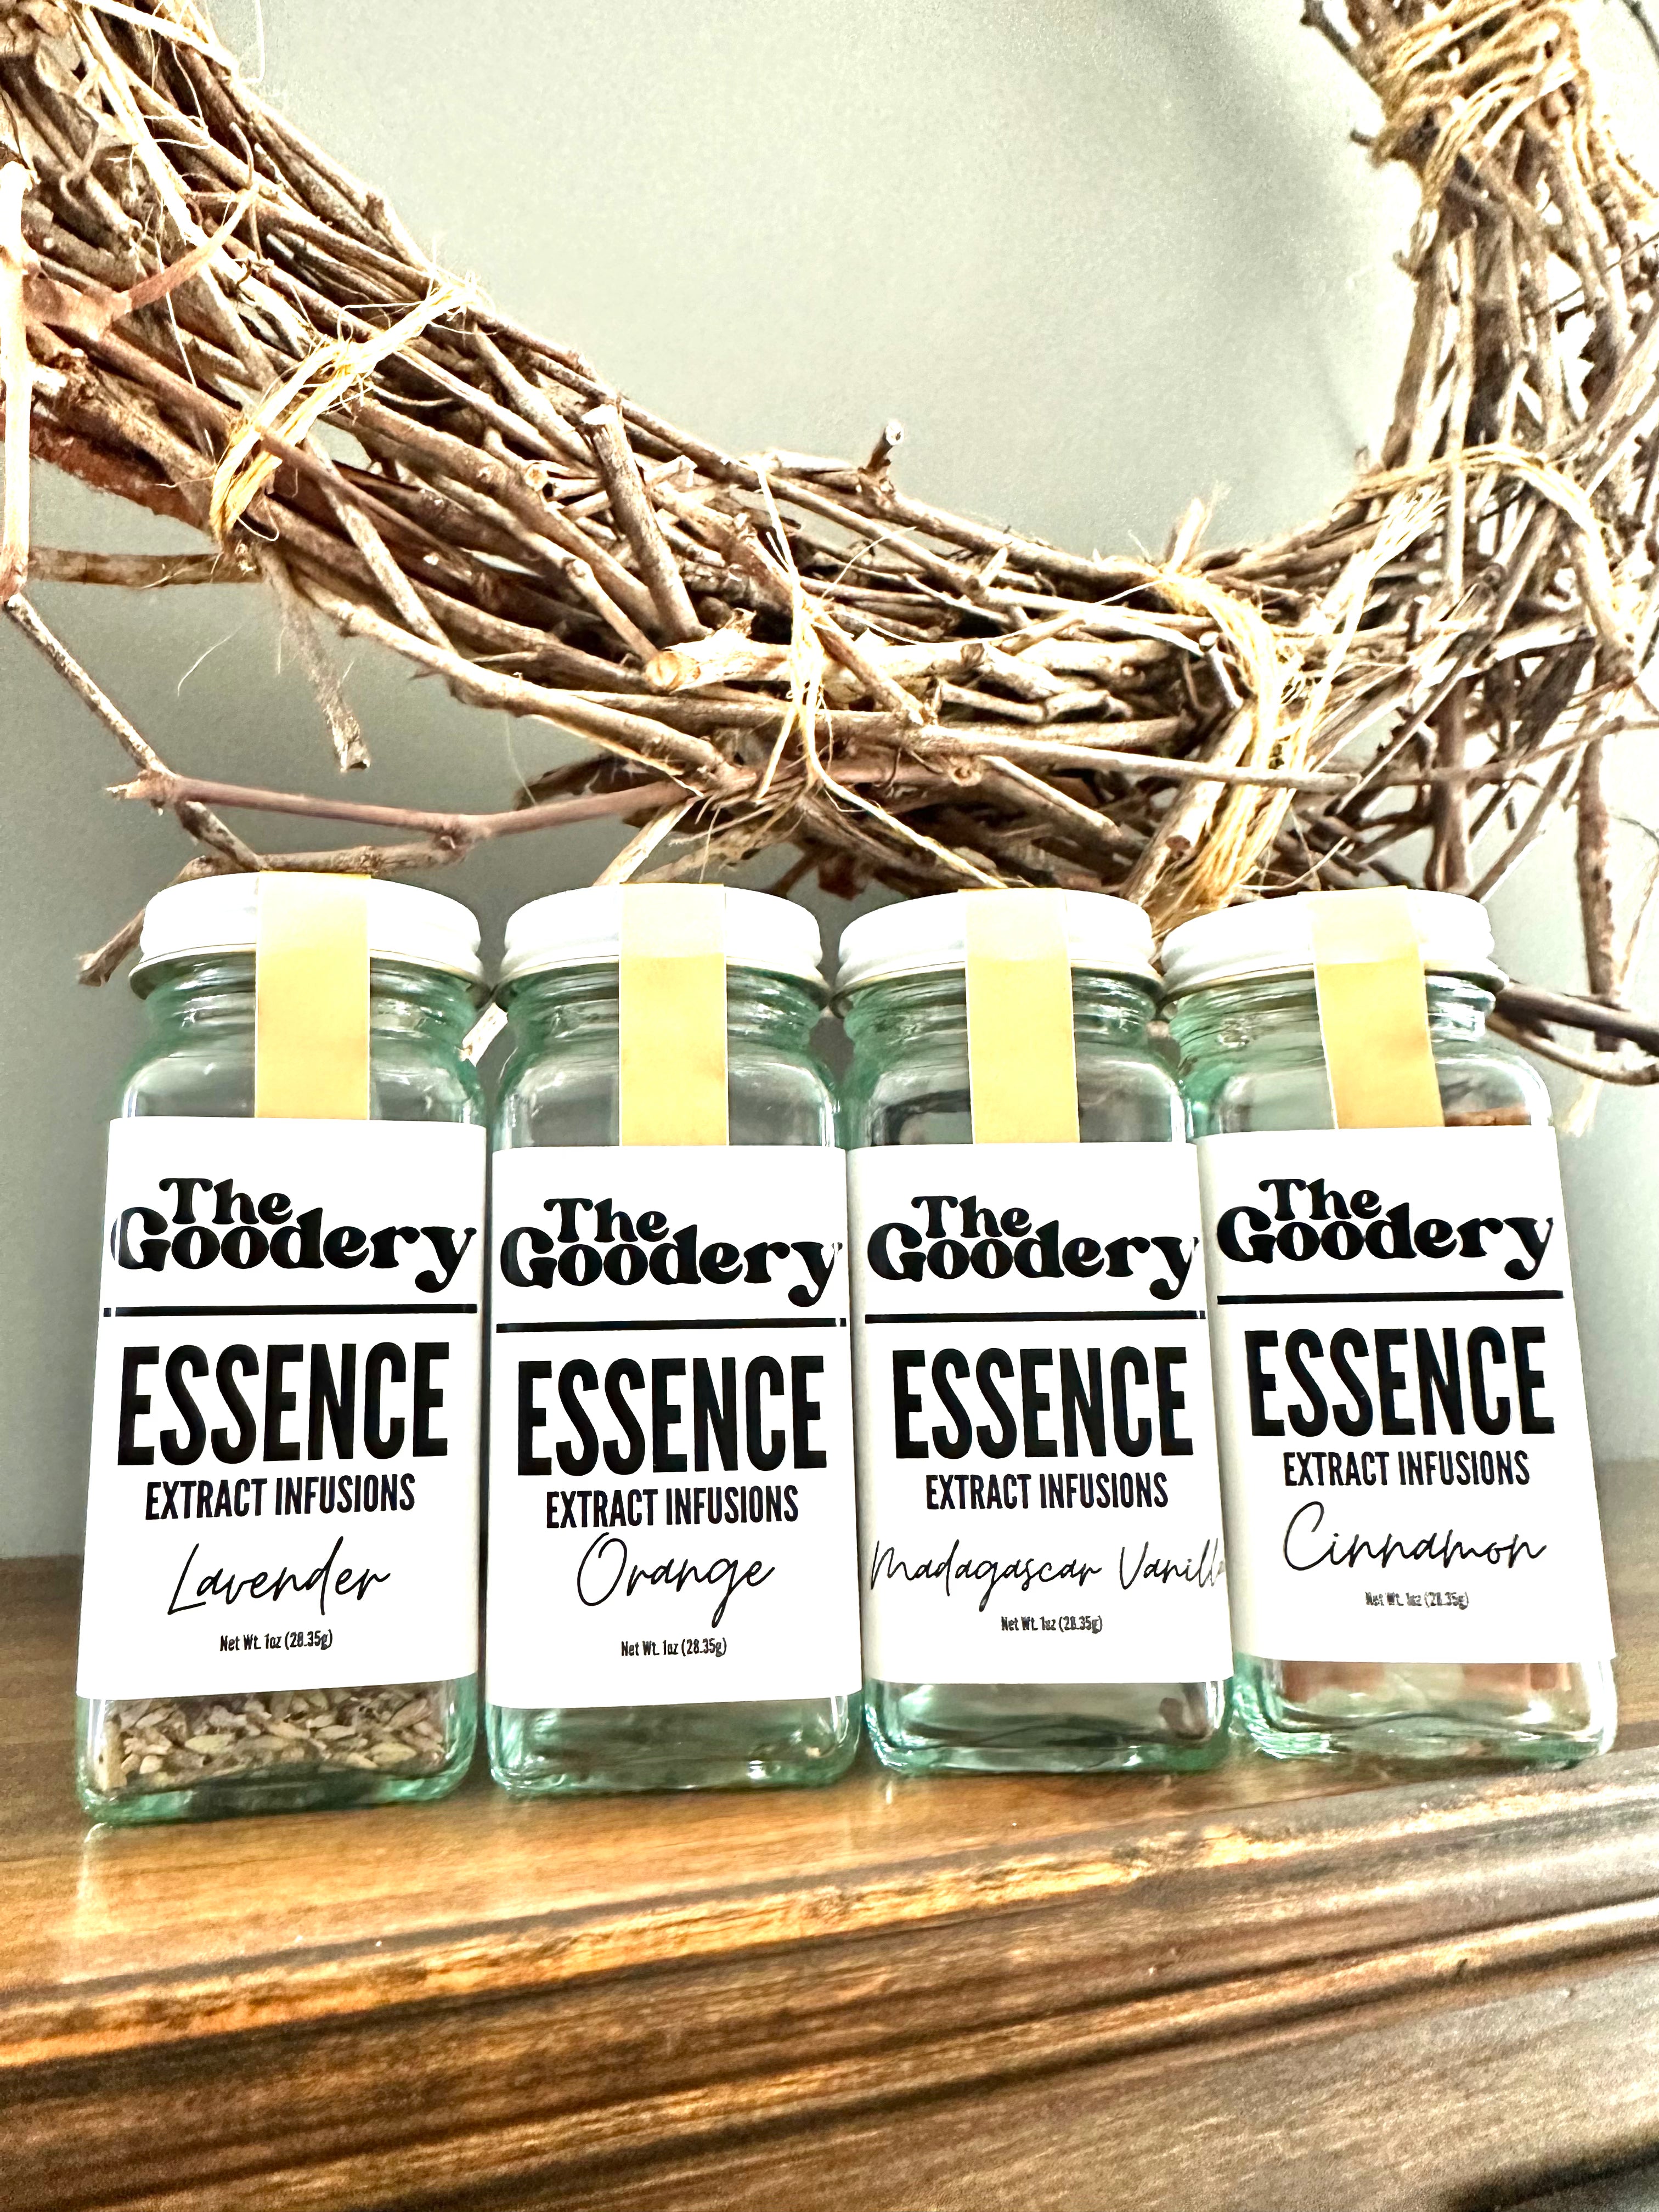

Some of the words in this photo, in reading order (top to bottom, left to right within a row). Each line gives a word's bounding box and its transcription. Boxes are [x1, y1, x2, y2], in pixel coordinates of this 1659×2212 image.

[159, 1177, 293, 1225] The
[544, 1198, 669, 1243] The
[911, 1195, 1032, 1239] The
[1259, 1178, 1382, 1221] The
[111, 1207, 477, 1293] Goodery
[500, 1224, 843, 1307] Goodery
[867, 1220, 1200, 1300] Goodery
[1216, 1202, 1554, 1280] Goodery
[117, 1342, 449, 1466] ESSENCE
[517, 1355, 827, 1477] ESSENCE
[892, 1346, 1194, 1460] ESSENCE
[1244, 1326, 1555, 1437] ESSENCE
[145, 1479, 268, 1520] EXTRACT
[275, 1472, 415, 1515] INFUSIONS
[926, 1474, 1032, 1510] EXTRACT
[1039, 1472, 1169, 1509] INFUSIONS
[1283, 1451, 1390, 1486] EXTRACT
[1398, 1449, 1530, 1486] INFUSIONS
[546, 1488, 658, 1529] EXTRACT
[666, 1485, 799, 1526] INFUSIONS
[1283, 1501, 1547, 1571] Cinnamon
[167, 1536, 391, 1616] Lavender
[577, 1532, 776, 1628] Orange
[870, 1539, 1102, 1612] Madagascar
[220, 1635, 240, 1651] Net
[244, 1634, 262, 1651] Wt.
[264, 1633, 282, 1649] 1oz
[285, 1629, 333, 1651] (28.35g)
[621, 1640, 640, 1656] Net
[642, 1640, 660, 1656] Wt.
[663, 1640, 679, 1655] 1oz
[681, 1638, 727, 1657] (28.35g)
[1001, 1616, 1019, 1631] Net
